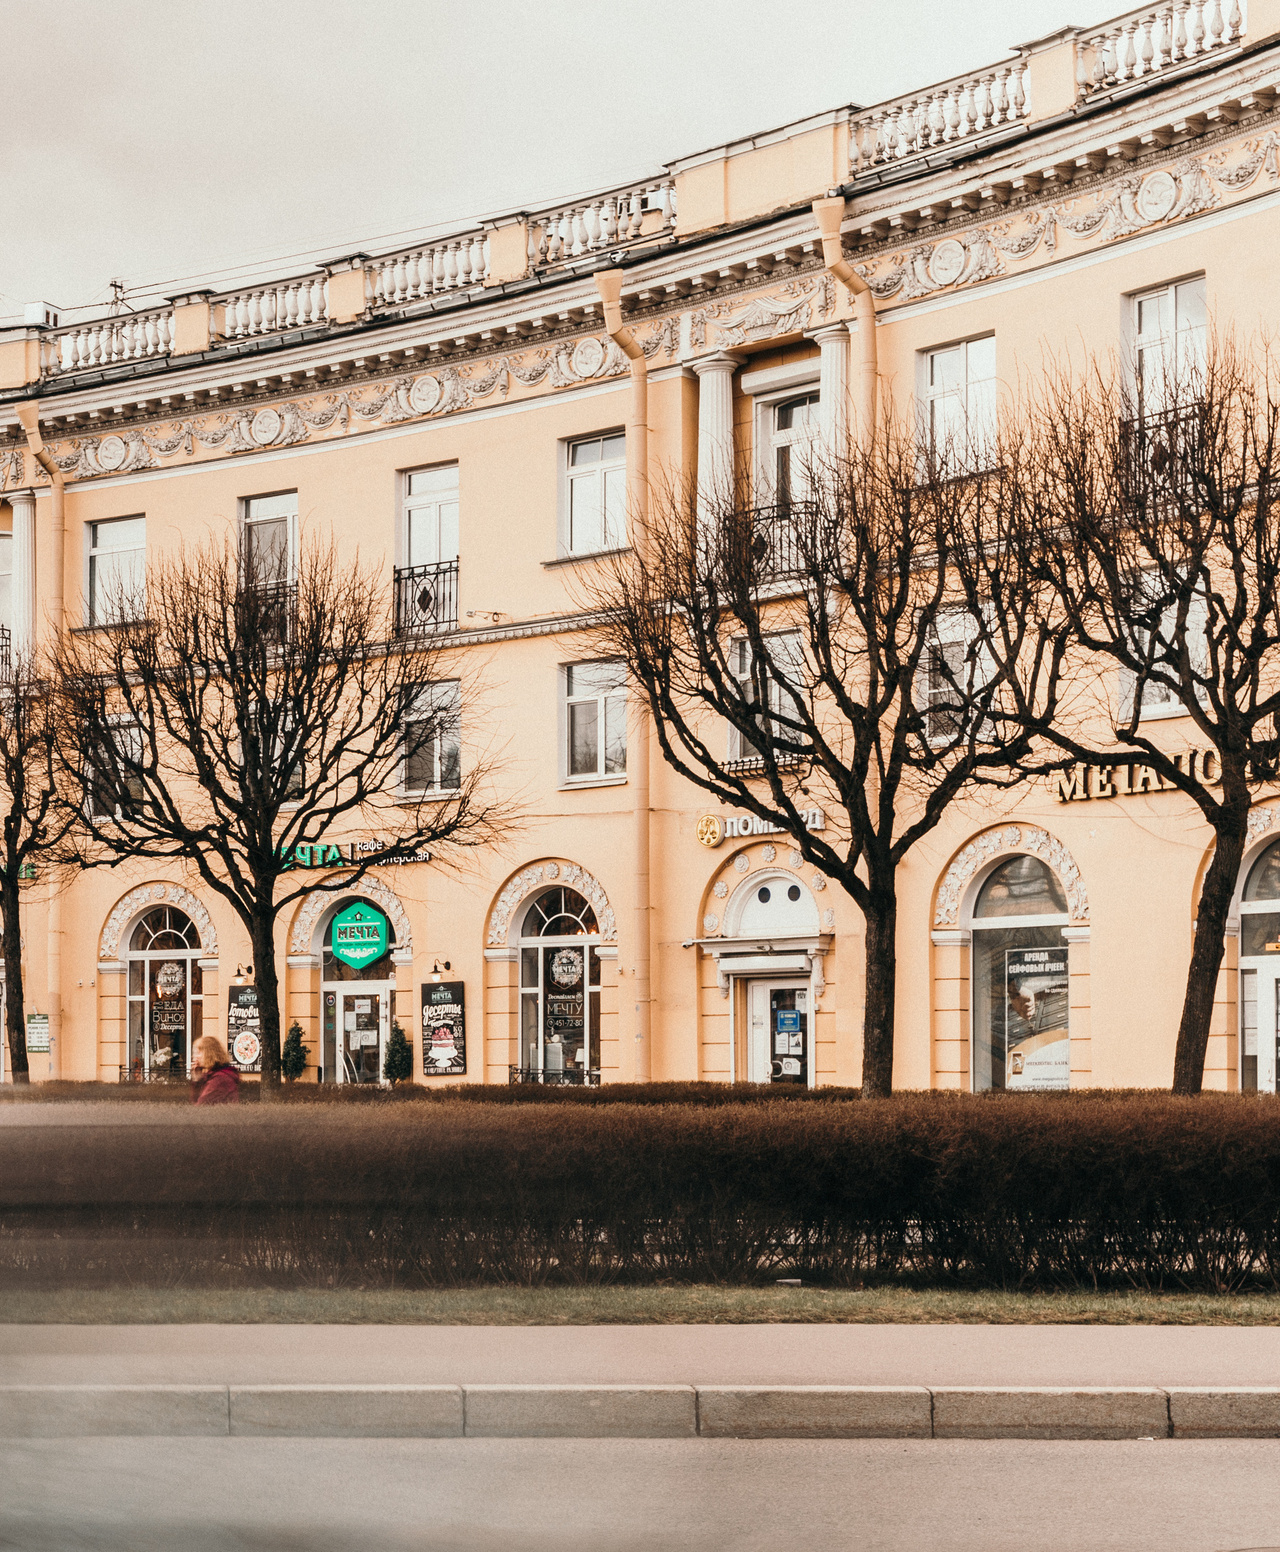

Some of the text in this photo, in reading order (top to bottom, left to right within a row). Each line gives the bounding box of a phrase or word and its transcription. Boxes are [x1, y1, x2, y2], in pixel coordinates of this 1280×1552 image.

[724, 808, 826, 838] ЛОМРД
[357, 838, 383, 853] кафе
[272, 843, 344, 869] ЕЧТА
[337, 926, 380, 940] МЕЧТА
[1024, 952, 1049, 963] АРЕНДА
[1009, 963, 1045, 974] СЕЙФОВЫХ
[228, 1003, 260, 1018] Готови
[547, 1002, 583, 1015] МЕЧТУ
